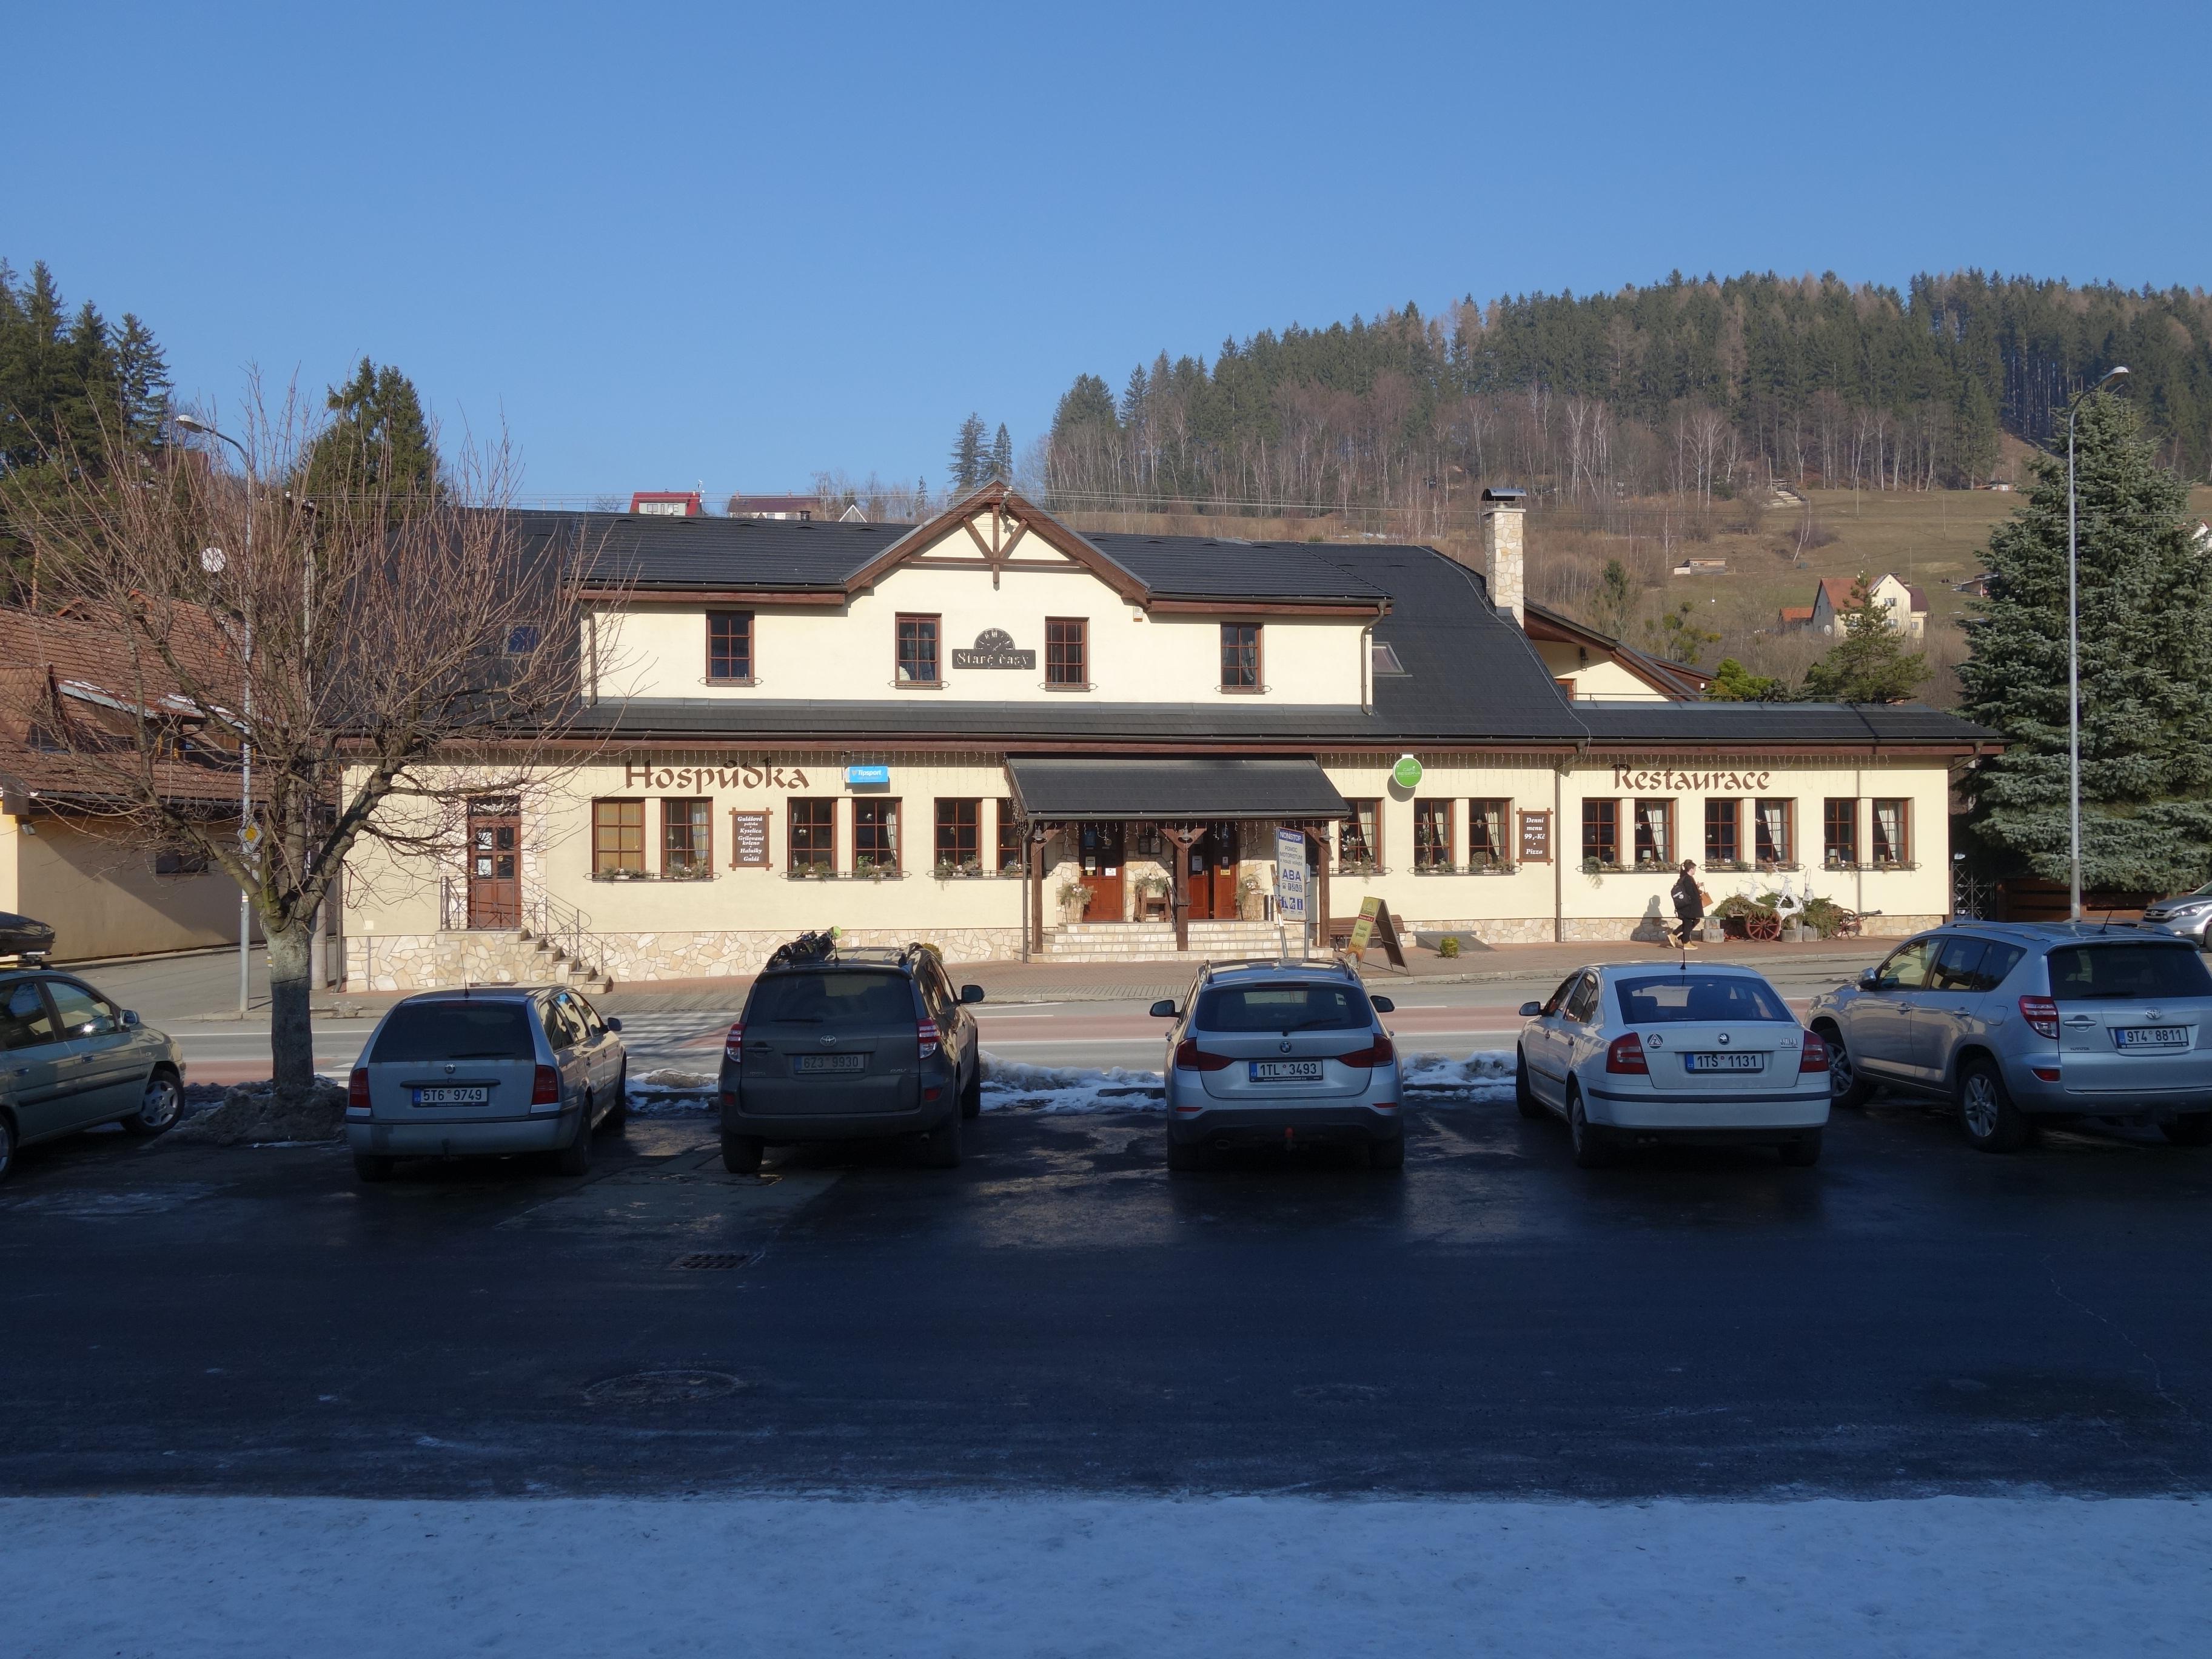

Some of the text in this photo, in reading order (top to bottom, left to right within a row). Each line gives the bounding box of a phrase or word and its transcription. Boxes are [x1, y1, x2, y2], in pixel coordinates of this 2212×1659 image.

[625, 757, 809, 794] Hospůdka
[1611, 764, 1770, 790] Restaurace
[1280, 831, 1302, 841] NONSTOP
[1282, 869, 1302, 882] ABA
[2127, 1030, 2182, 1042] 9T4 8811
[804, 1056, 859, 1068] 6Z3 9930
[1697, 1056, 1718, 1067] 1TS
[1728, 1055, 1756, 1067] 1131
[1260, 1064, 1280, 1076] 1TL
[1289, 1063, 1317, 1074] 3493
[423, 1090, 444, 1101] 5T6
[454, 1089, 481, 1101] 9749
